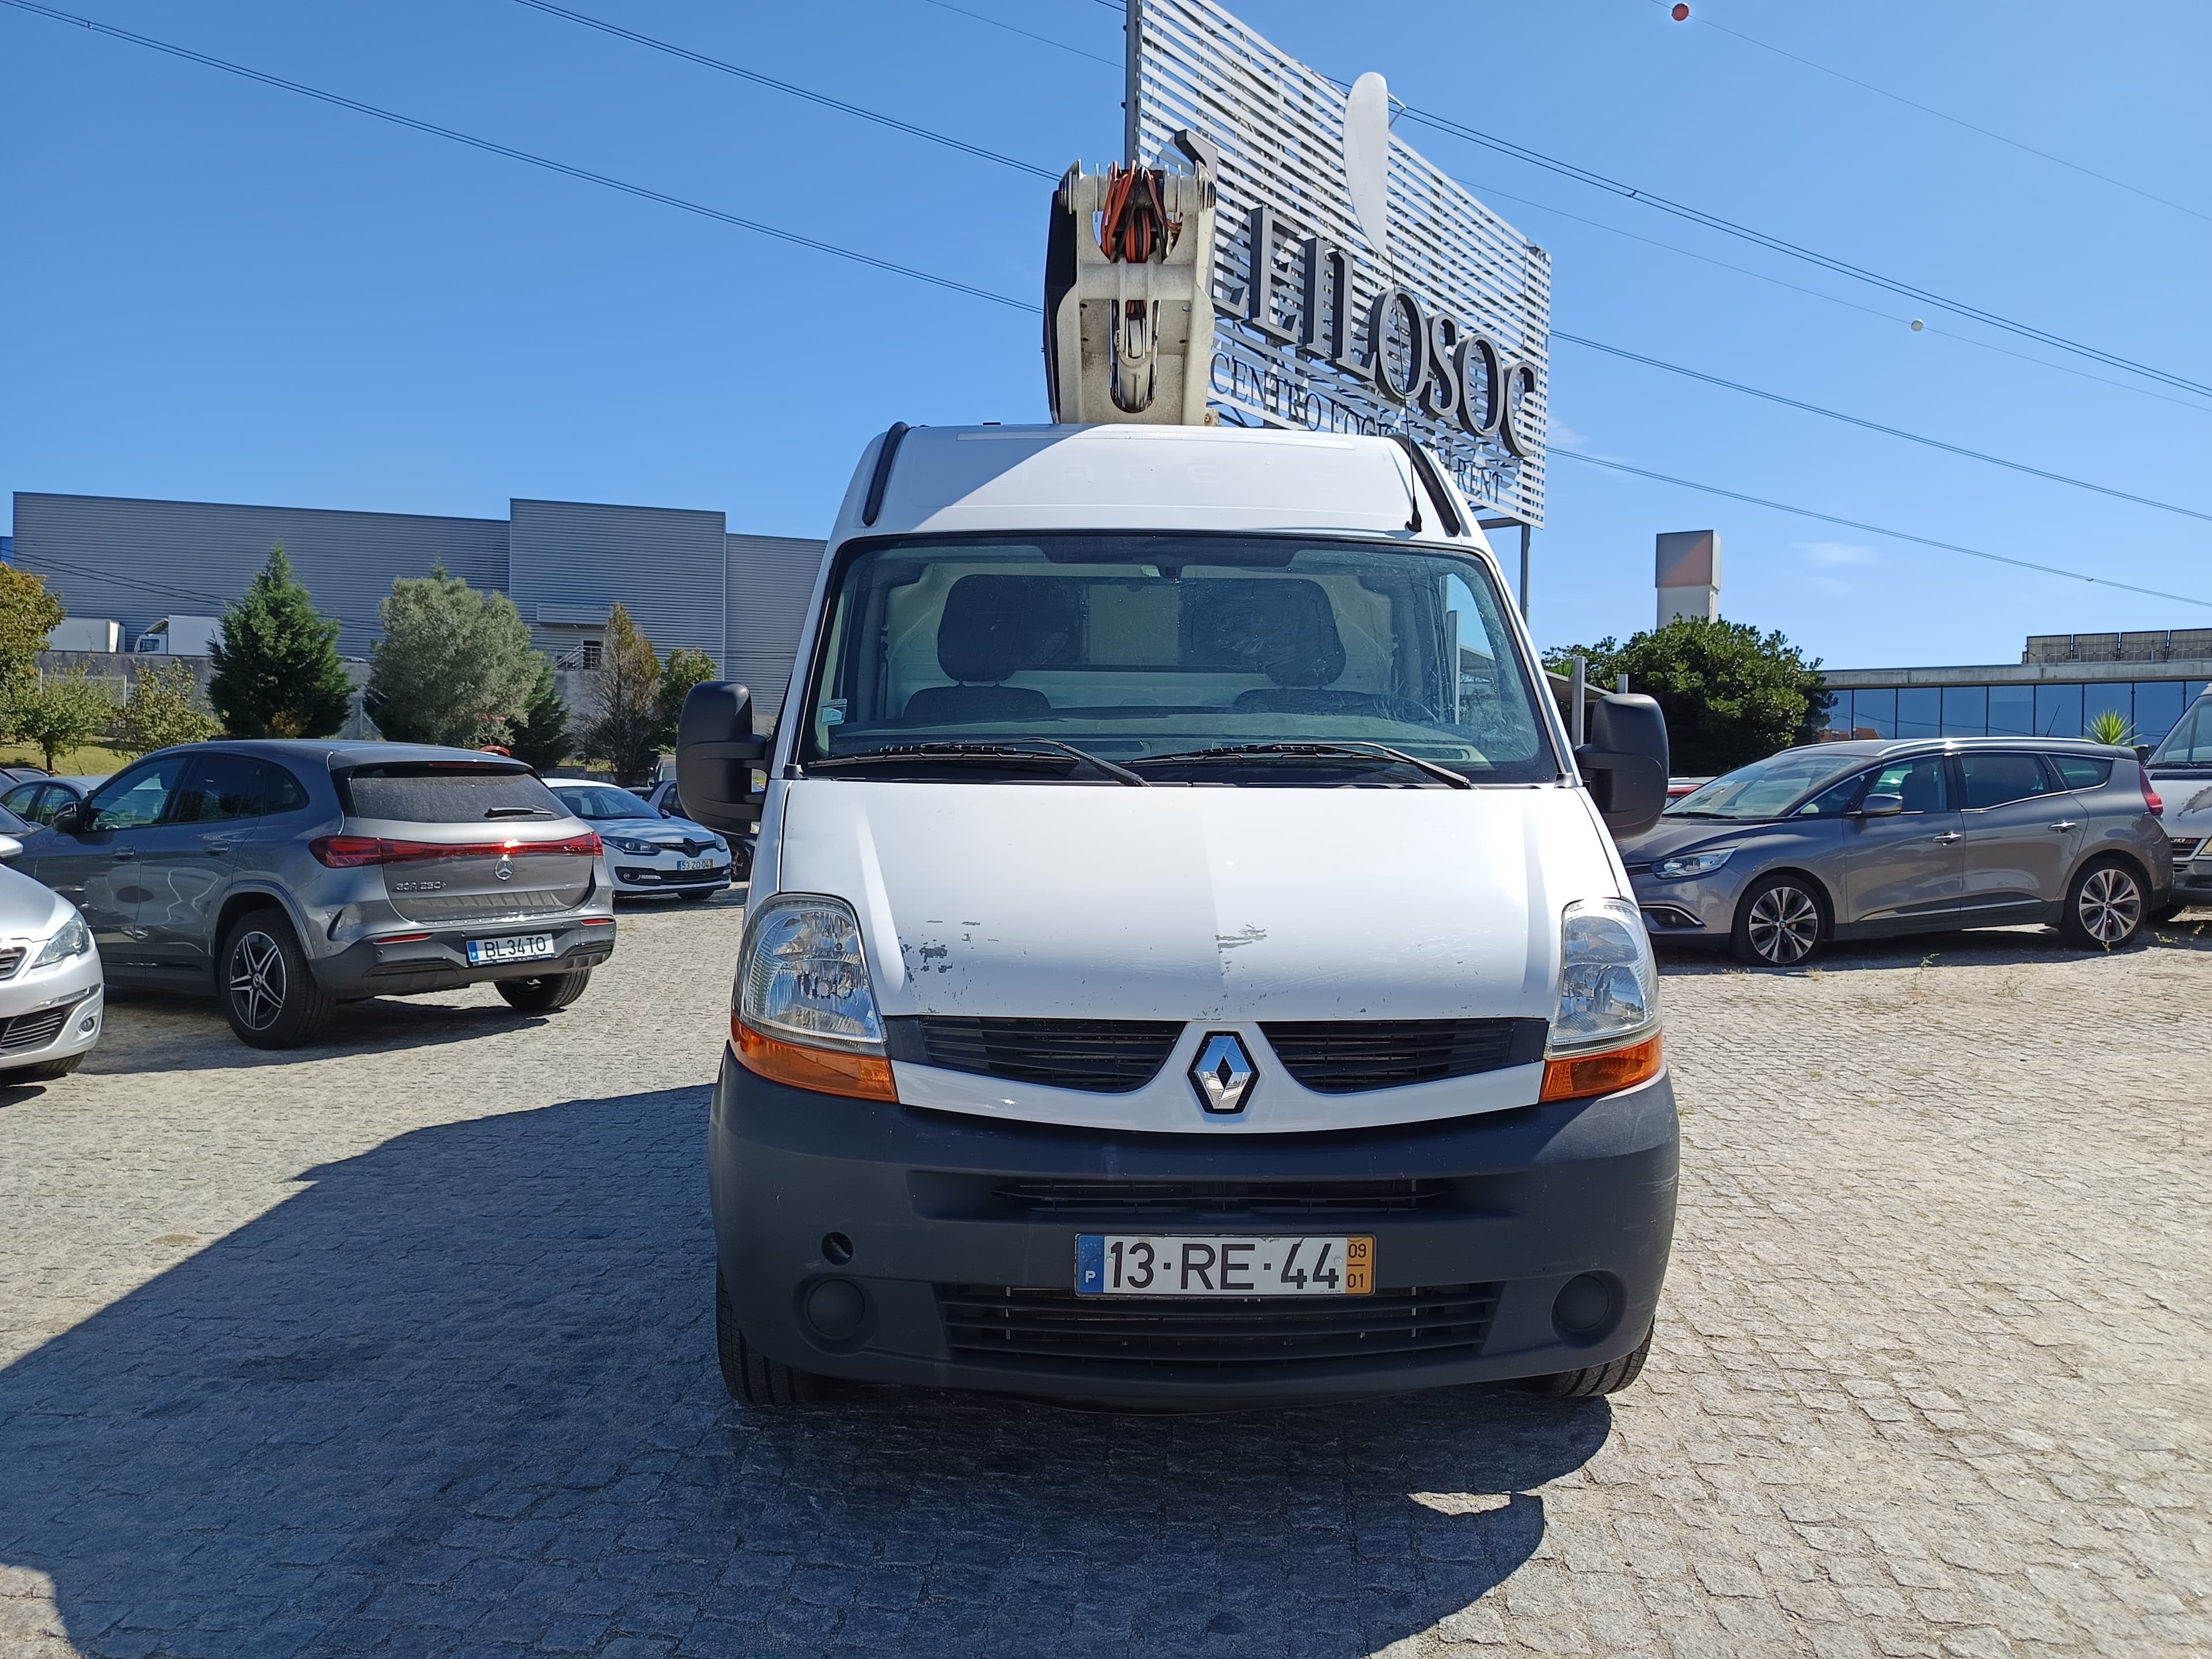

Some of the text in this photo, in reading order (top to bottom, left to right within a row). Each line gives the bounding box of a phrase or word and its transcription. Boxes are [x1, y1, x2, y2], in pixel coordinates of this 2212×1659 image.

[1210, 353, 1322, 431] CENTRO
[1457, 457, 1503, 504] RENT
[1348, 1244, 1367, 1259] 09
[1085, 1271, 1096, 1283] P
[1347, 1274, 1366, 1289] 01
